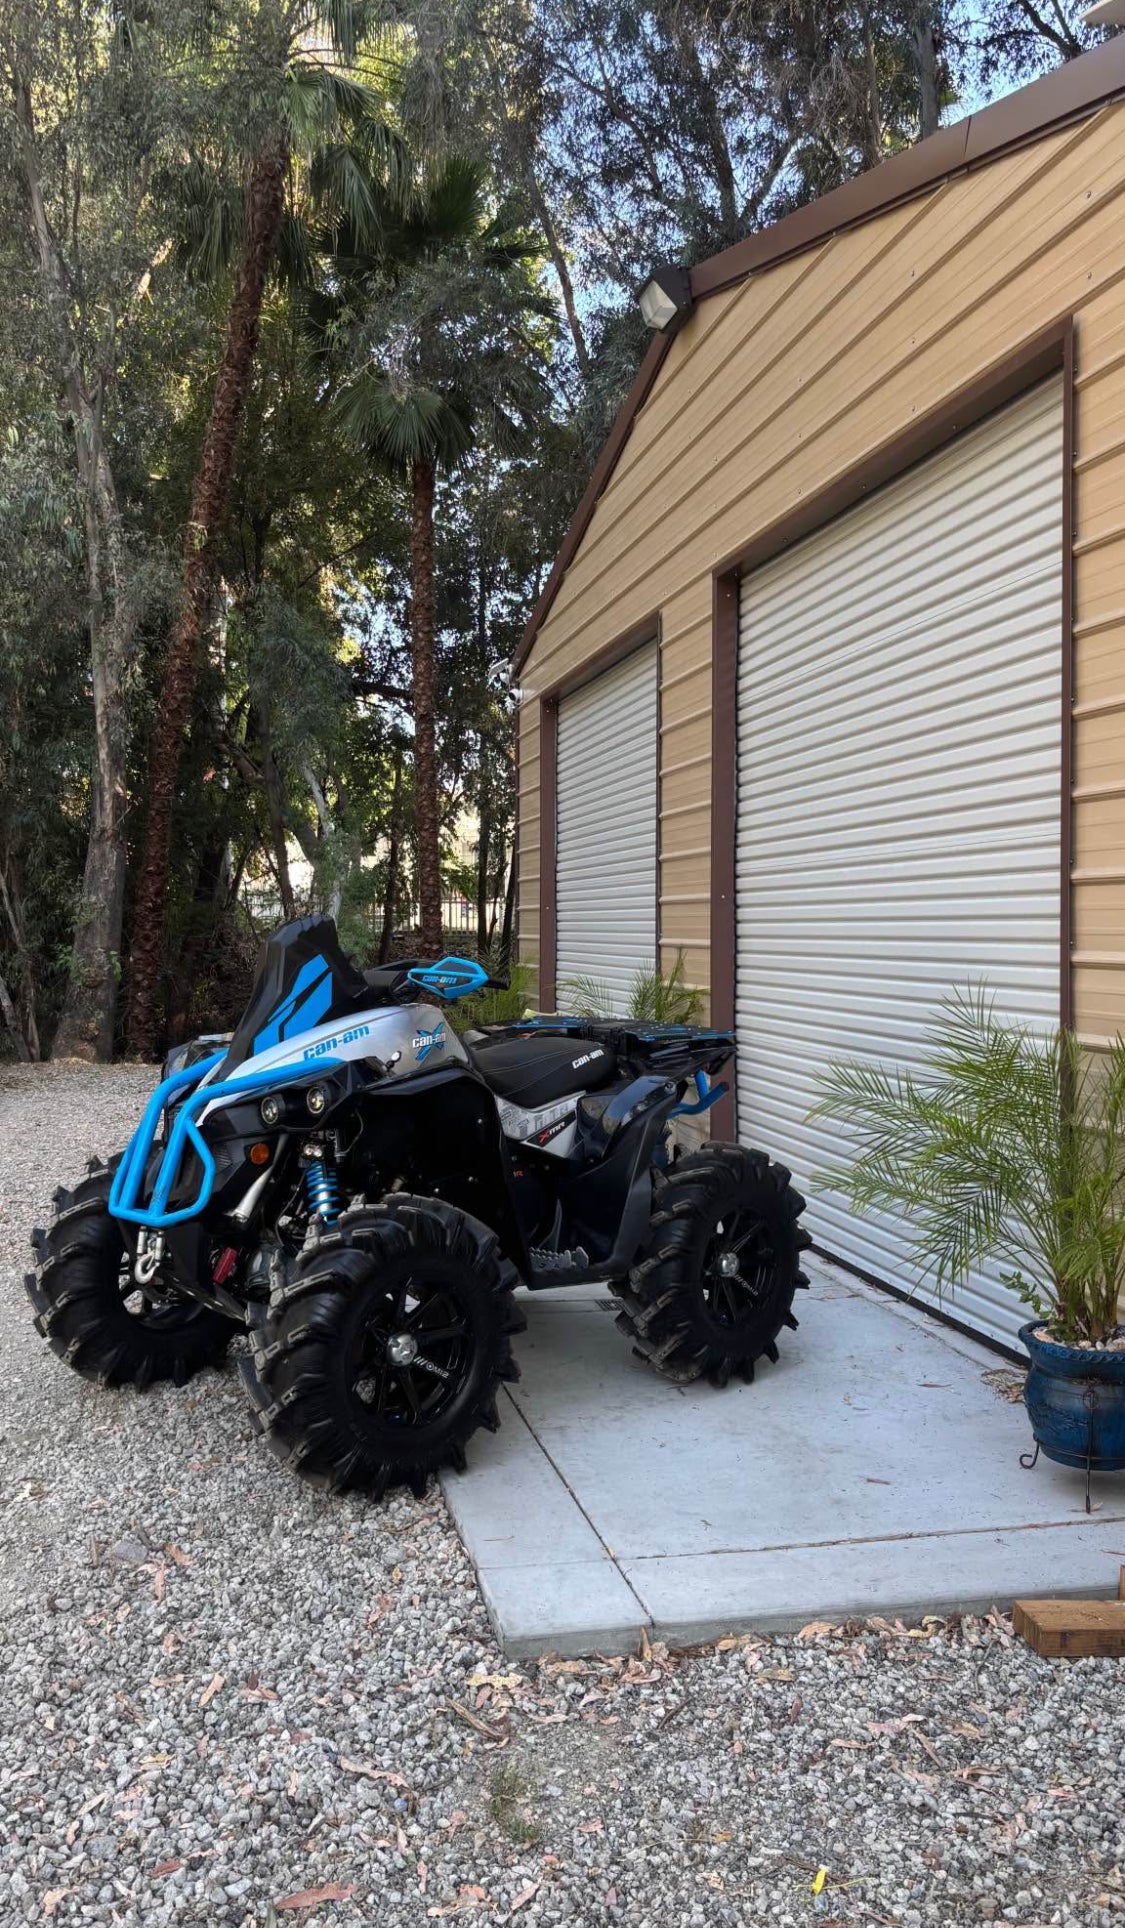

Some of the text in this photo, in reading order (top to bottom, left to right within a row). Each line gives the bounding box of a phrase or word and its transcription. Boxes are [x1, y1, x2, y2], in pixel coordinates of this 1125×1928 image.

[421, 975, 457, 984] can-am
[303, 1026, 370, 1060] can-am
[571, 1049, 604, 1069] can-am
